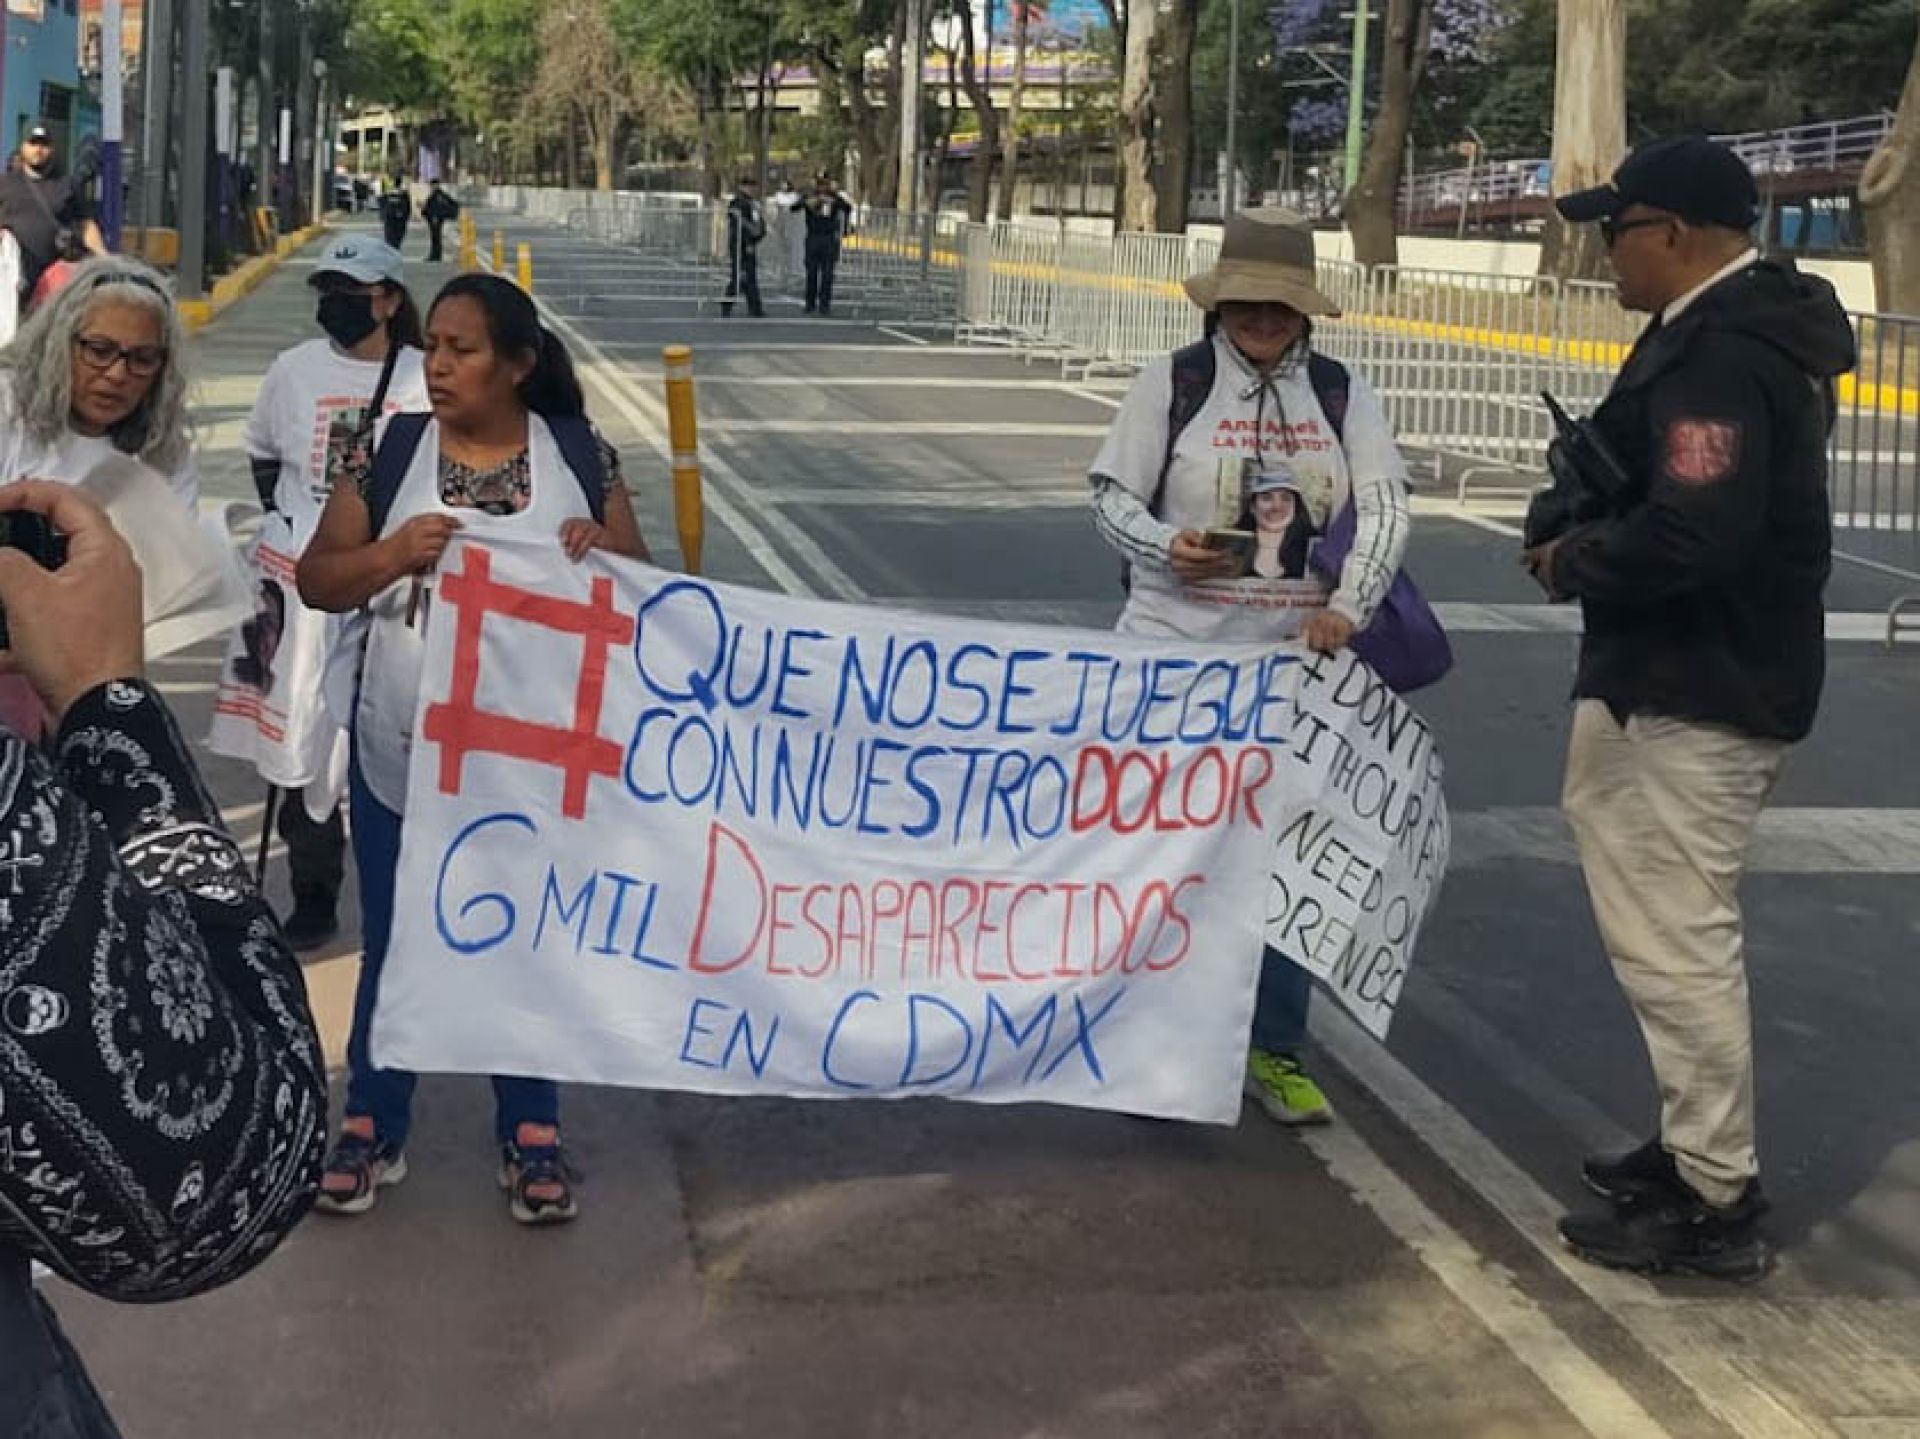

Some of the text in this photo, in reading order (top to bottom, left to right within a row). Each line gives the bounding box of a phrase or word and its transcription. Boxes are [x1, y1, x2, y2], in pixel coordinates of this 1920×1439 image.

[532, 862, 680, 971] MIL
[687, 820, 1207, 981] DESAPARECIDOS
[1277, 809, 1384, 913] NEED
[680, 984, 1129, 1090] EN CDMX
